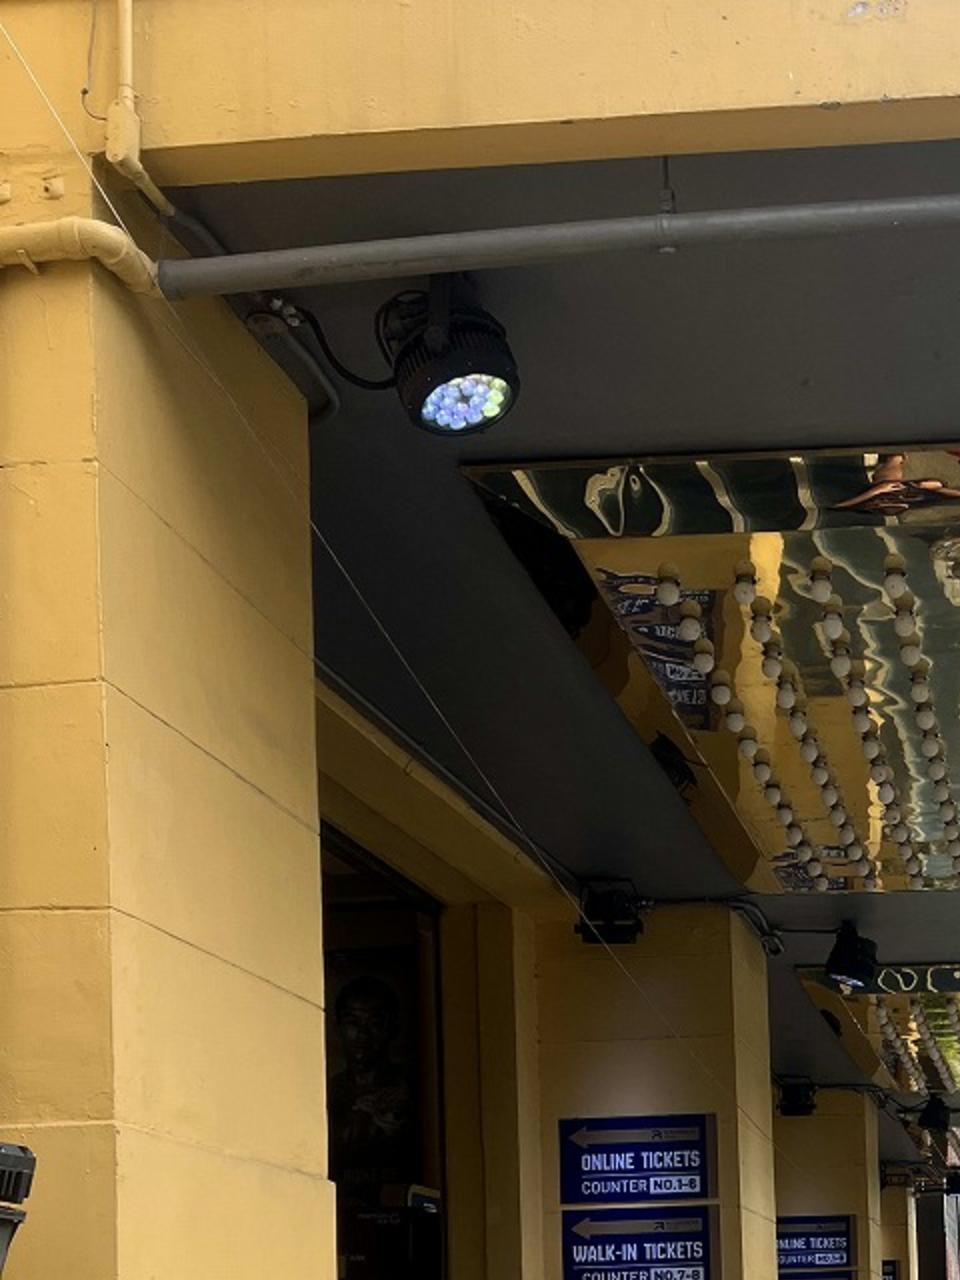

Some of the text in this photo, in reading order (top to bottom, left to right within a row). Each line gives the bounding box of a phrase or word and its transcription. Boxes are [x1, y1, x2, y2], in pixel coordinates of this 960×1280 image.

[581, 1150, 701, 1171] ONLINE TICKETS
[581, 1179, 648, 1195] COUNTER
[572, 1241, 703, 1262] WALK-IN TICKETS
